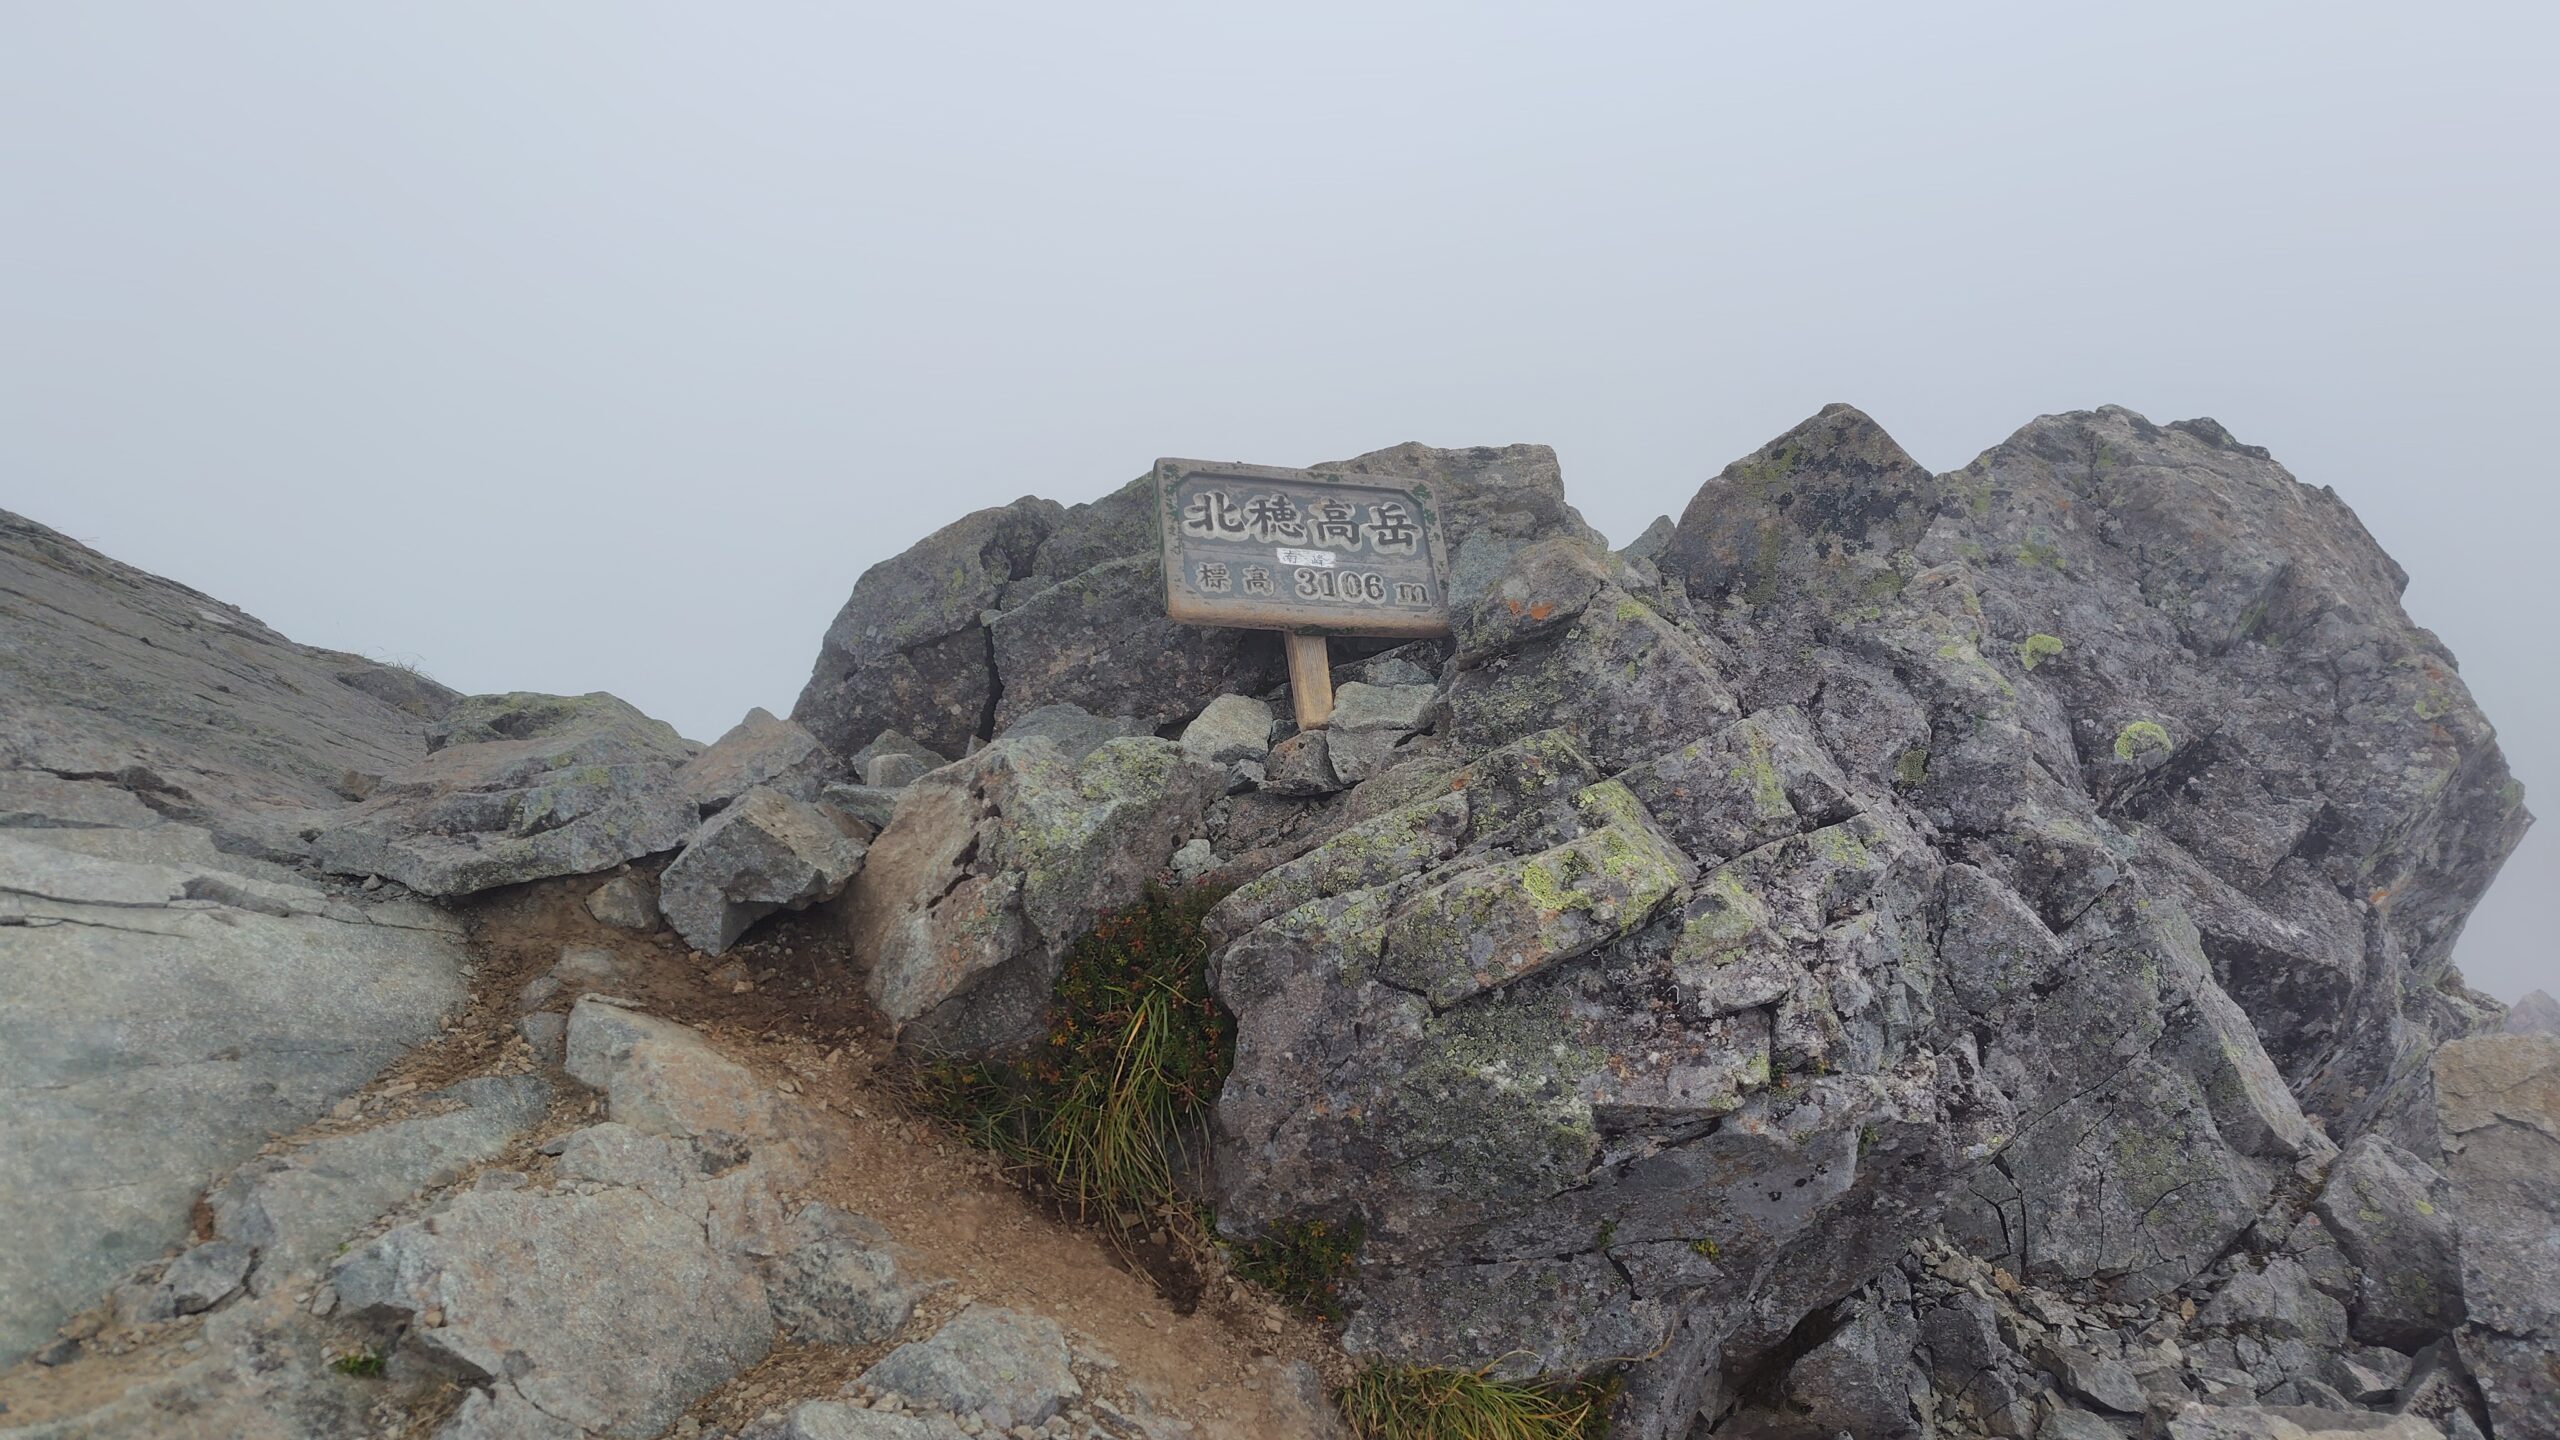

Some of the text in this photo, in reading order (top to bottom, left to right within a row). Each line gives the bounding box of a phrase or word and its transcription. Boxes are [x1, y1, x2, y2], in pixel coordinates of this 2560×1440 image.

[1182, 490, 1424, 555] 北穂高岳
[1197, 562, 1433, 607] 標高 3106 m
